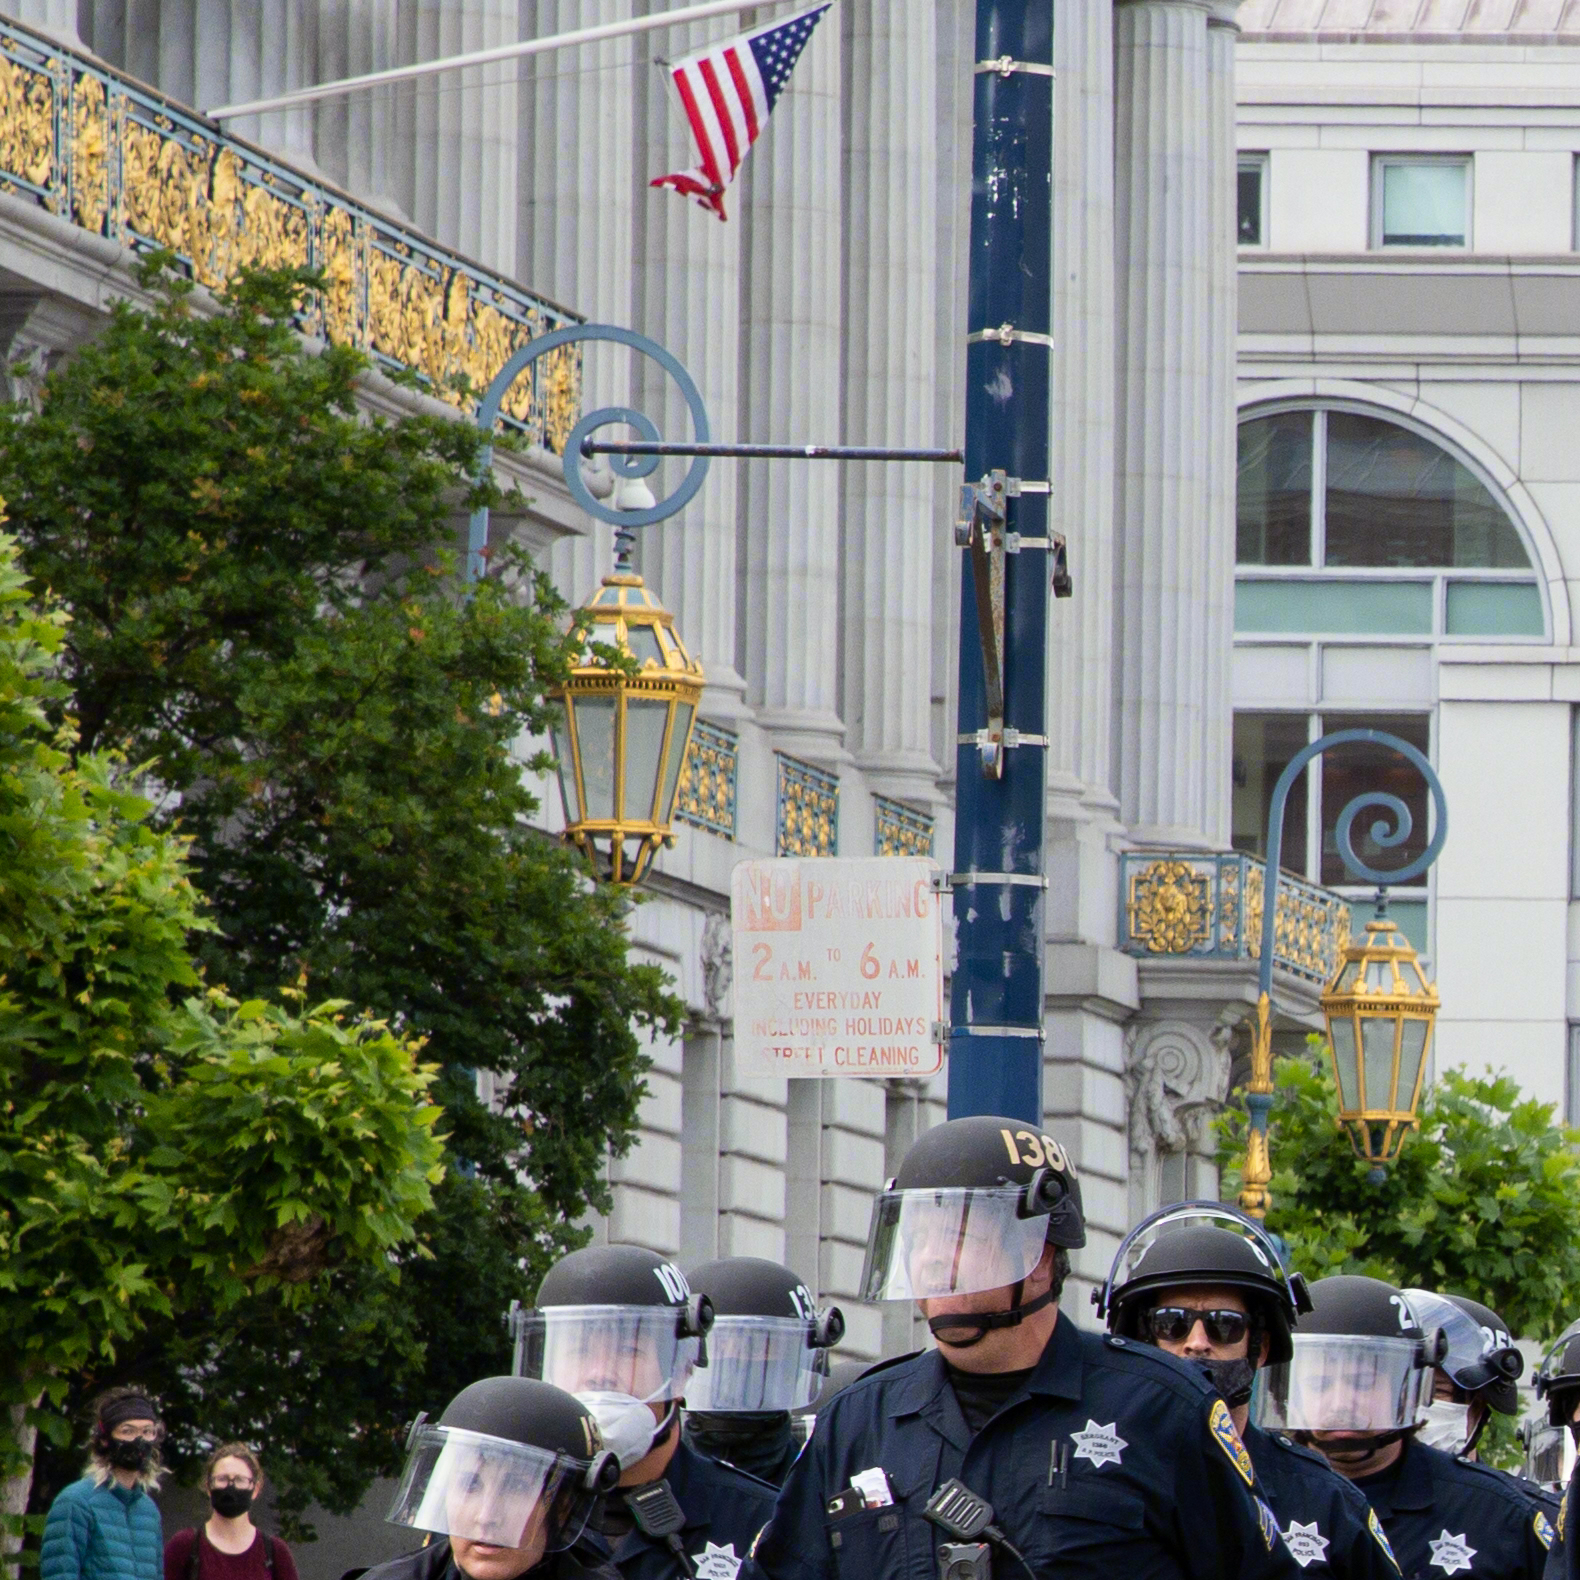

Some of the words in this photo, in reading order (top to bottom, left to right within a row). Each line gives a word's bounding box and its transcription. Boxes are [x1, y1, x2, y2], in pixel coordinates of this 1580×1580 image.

[752, 942, 773, 981] 2
[780, 960, 817, 981] A.M.
[827, 948, 841, 962] TO
[860, 941, 881, 979] 6
[888, 959, 926, 979] A.M.
[794, 991, 882, 1010] EVERYDAY
[845, 1016, 926, 1036] HOLIDAYS
[834, 1046, 919, 1066] CLEANING
